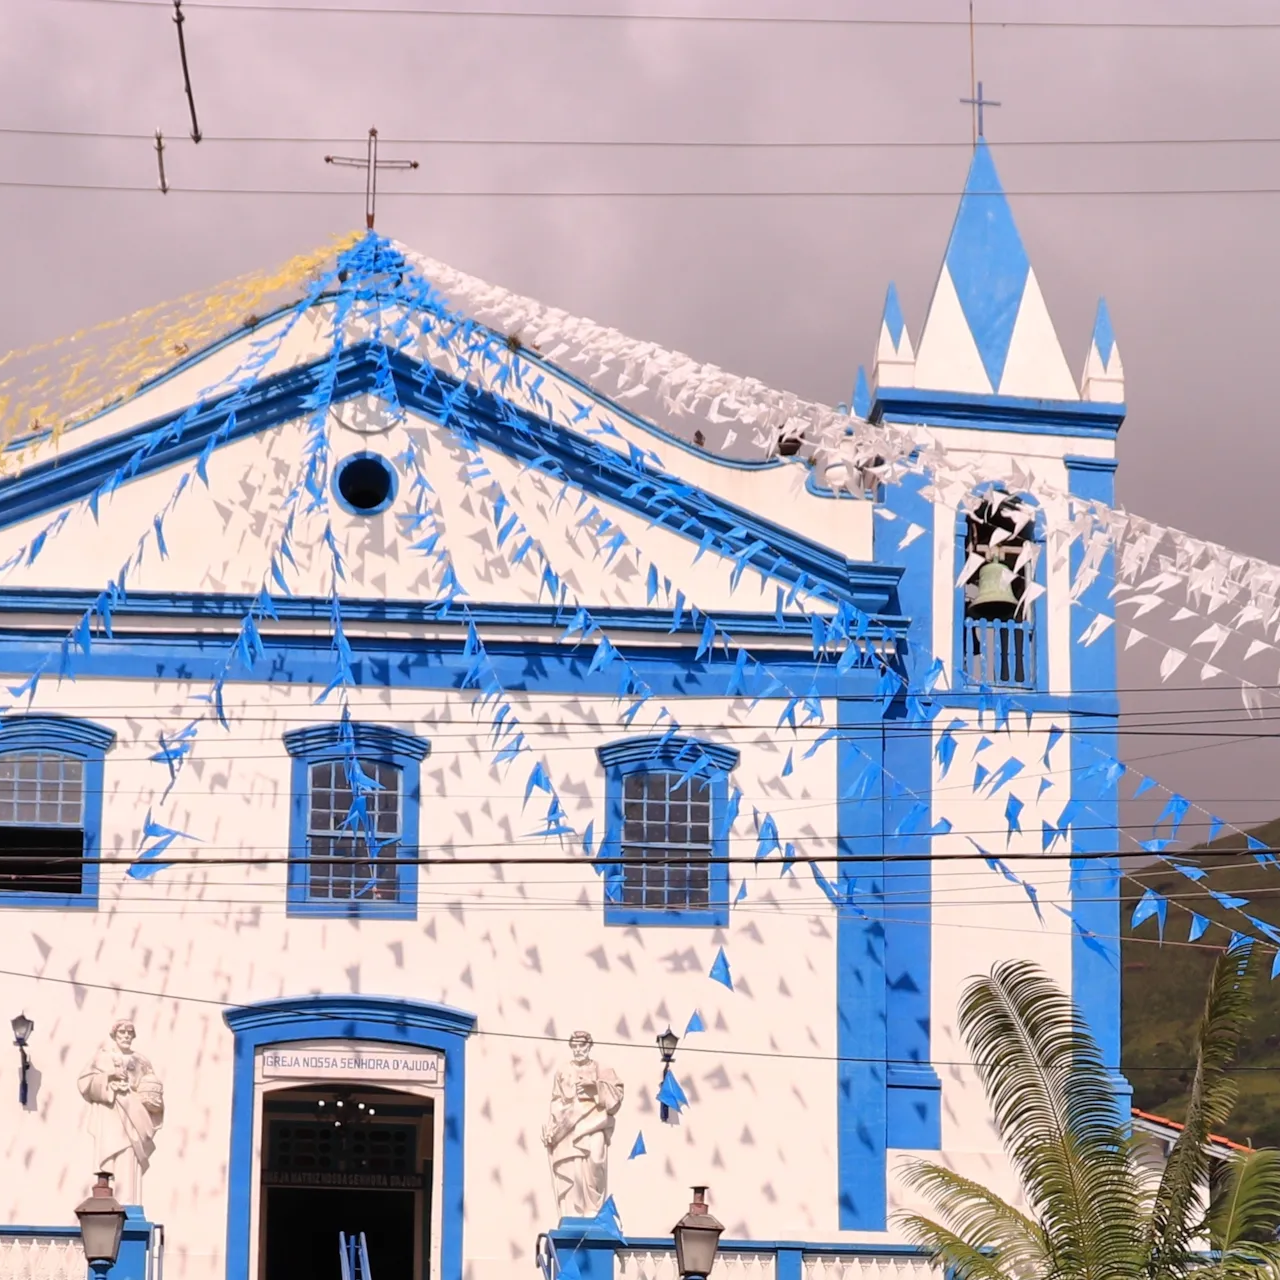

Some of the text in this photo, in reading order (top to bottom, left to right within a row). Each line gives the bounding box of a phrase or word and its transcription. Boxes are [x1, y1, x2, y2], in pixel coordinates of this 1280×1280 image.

[263, 1056, 438, 1072] IGREJA NOSSA SENHORA D'AJUDA
